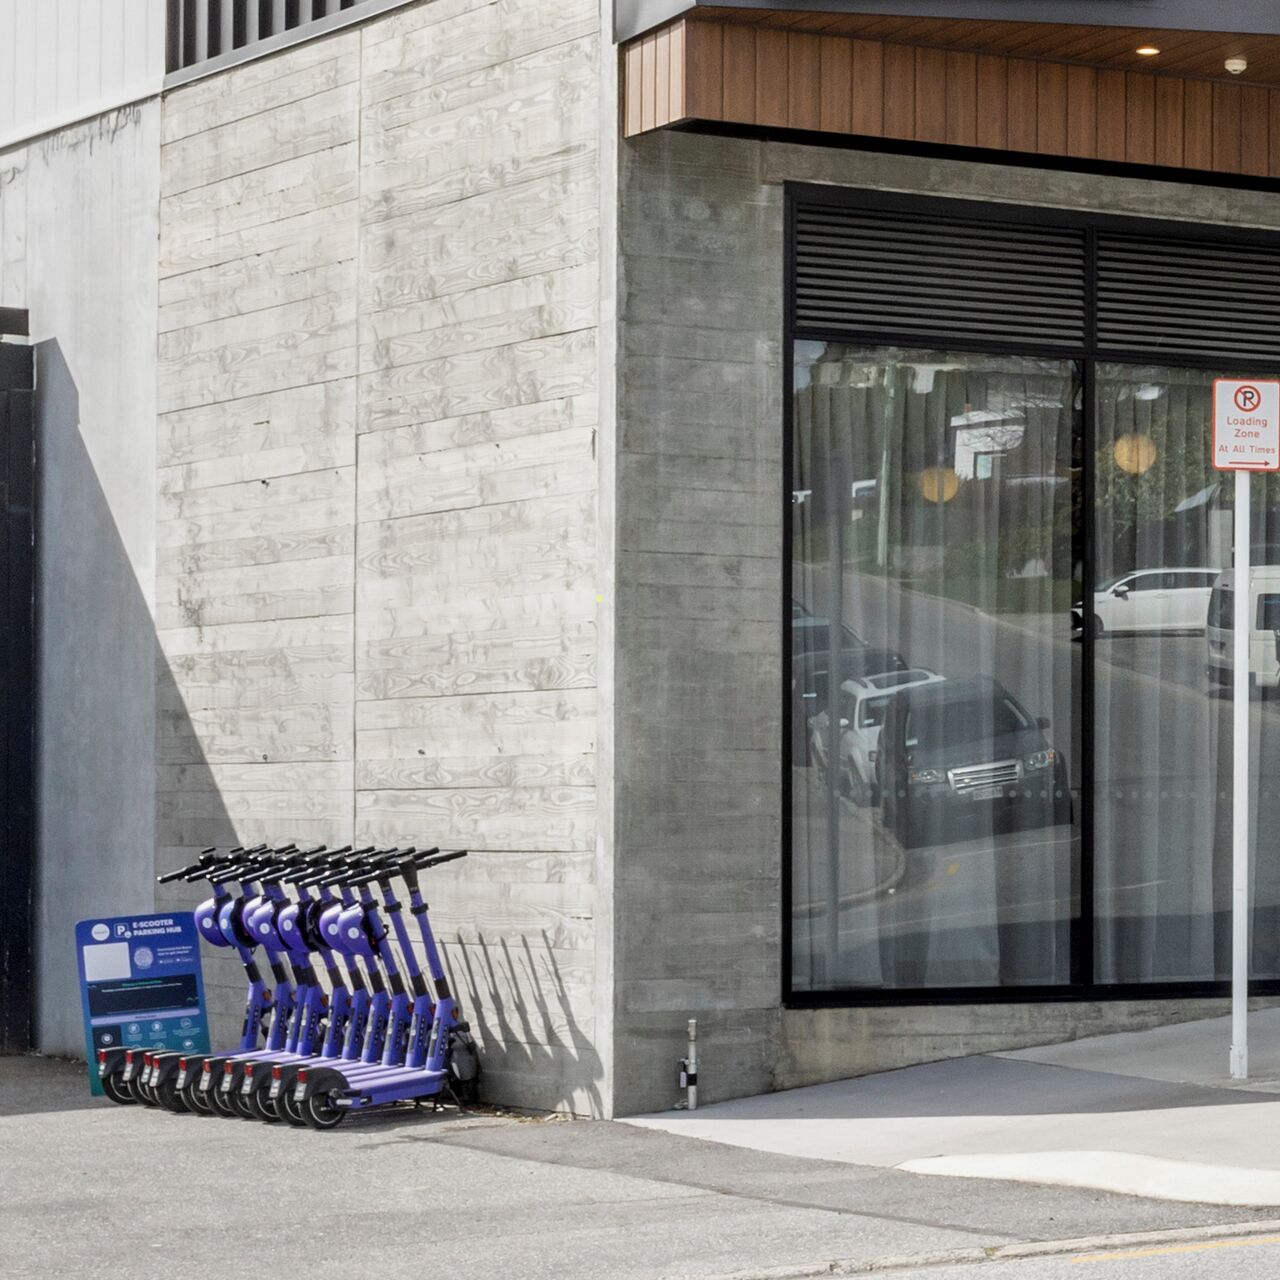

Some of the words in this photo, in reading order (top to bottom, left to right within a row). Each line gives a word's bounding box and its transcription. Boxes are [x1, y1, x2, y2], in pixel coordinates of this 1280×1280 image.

[1226, 416, 1268, 428] Loading
[1234, 429, 1260, 438] Zone
[1218, 444, 1229, 453] At
[1232, 445, 1245, 453] All
[1249, 445, 1276, 454] Times
[132, 918, 174, 928] E-SCOOTER
[133, 927, 166, 937] PARKING
[166, 925, 182, 934] HUB
